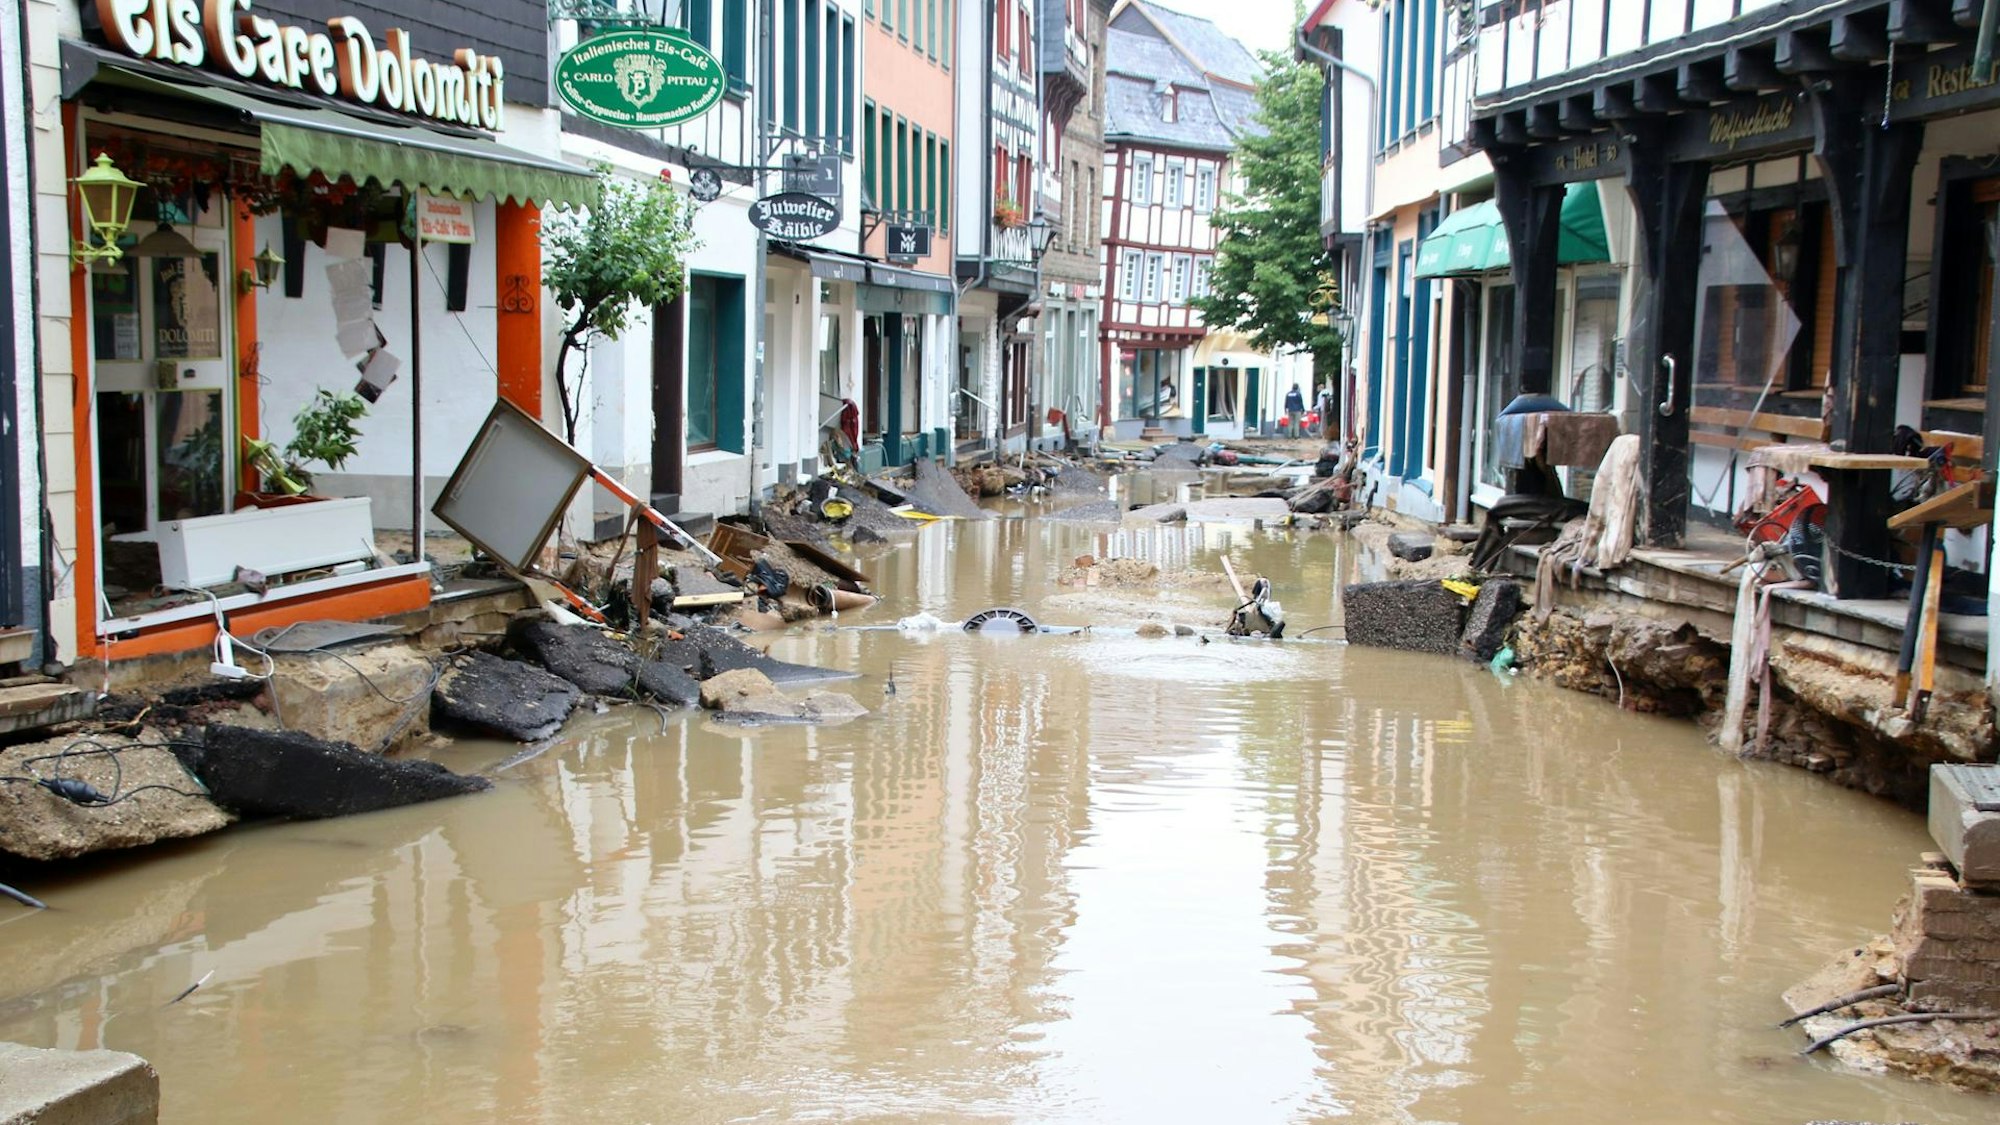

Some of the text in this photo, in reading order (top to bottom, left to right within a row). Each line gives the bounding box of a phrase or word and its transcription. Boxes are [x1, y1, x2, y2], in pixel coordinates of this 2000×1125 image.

[572, 37, 709, 71] Italienisches Eis-Café
[214, 0, 338, 95] Cafe
[340, 16, 505, 132] Dolomiti
[573, 72, 614, 83] CARLO
[667, 75, 708, 86] PITTAU
[757, 199, 835, 222] Juwelier
[763, 216, 824, 238] Kälble
